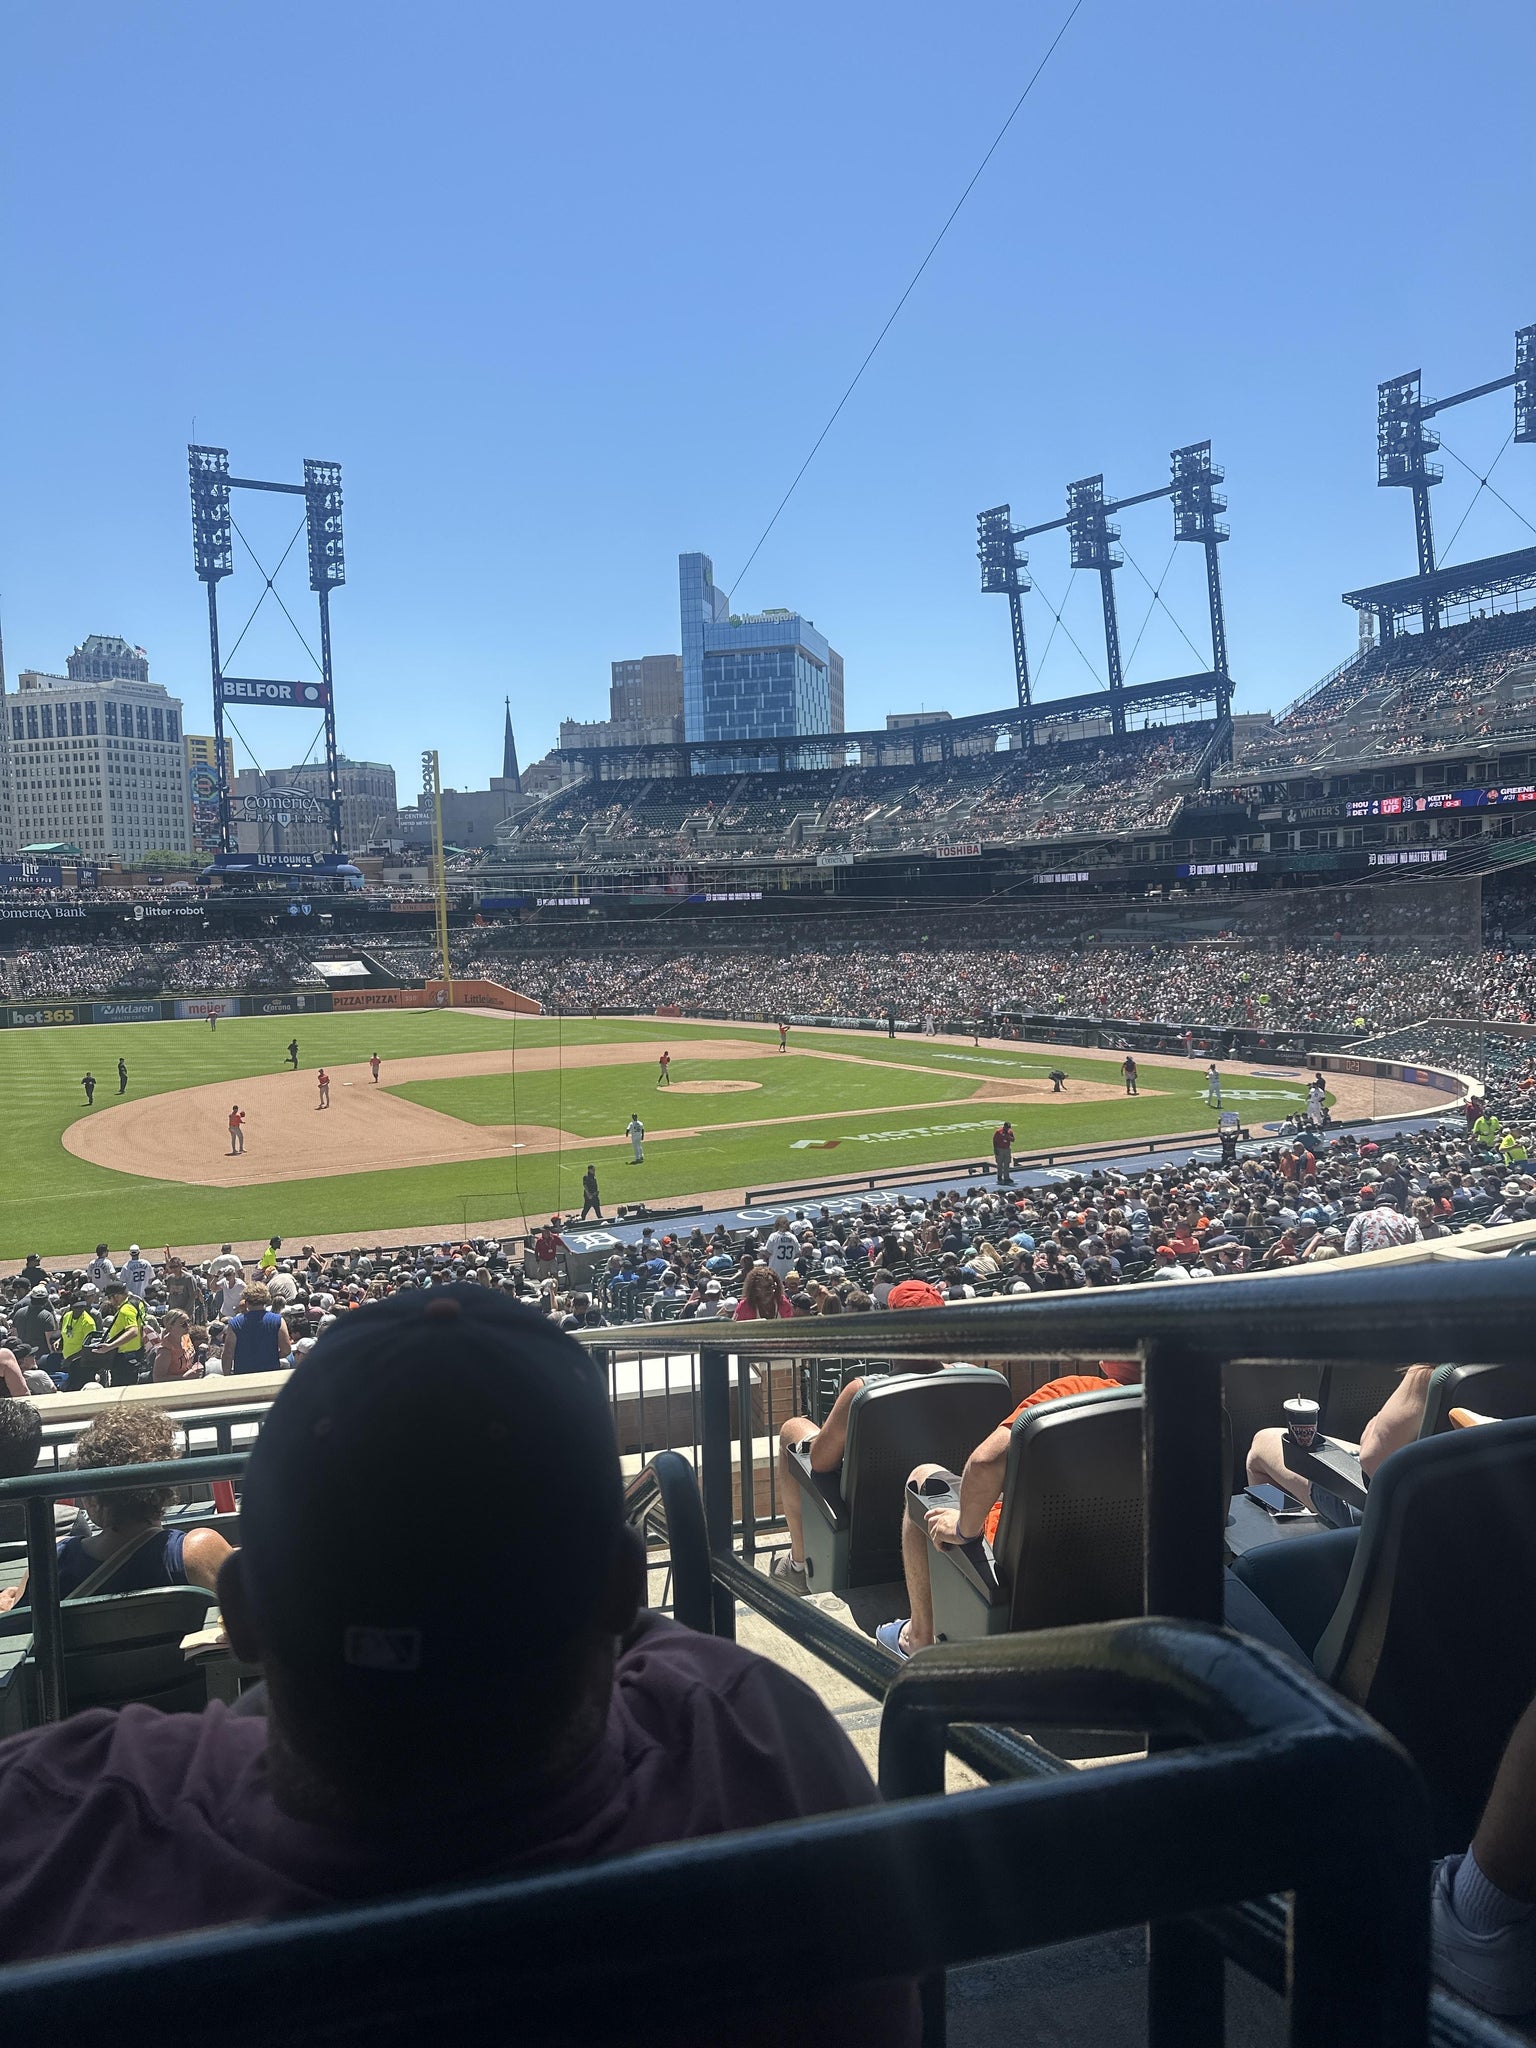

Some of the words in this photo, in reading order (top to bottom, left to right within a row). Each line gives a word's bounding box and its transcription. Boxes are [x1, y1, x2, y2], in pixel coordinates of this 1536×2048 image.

[223, 682, 292, 699] BELFOR
[1500, 785, 1535, 795] GREENE
[1427, 794, 1452, 802] KEITH
[1352, 801, 1369, 809] HOU
[1383, 805, 1400, 813] UP
[1300, 806, 1340, 818] WINTER'S
[938, 846, 980, 857] TOSHIBA
[278, 855, 312, 864] LOUNGE
[1408, 851, 1430, 863] MATTER
[55, 907, 87, 917] Bank
[115, 1005, 154, 1014] McLaren
[263, 1003, 291, 1013] Corona
[12, 1010, 75, 1024] bet365
[777, 1245, 794, 1260] 33
[94, 1268, 101, 1279] 9
[132, 1270, 146, 1283] 28
